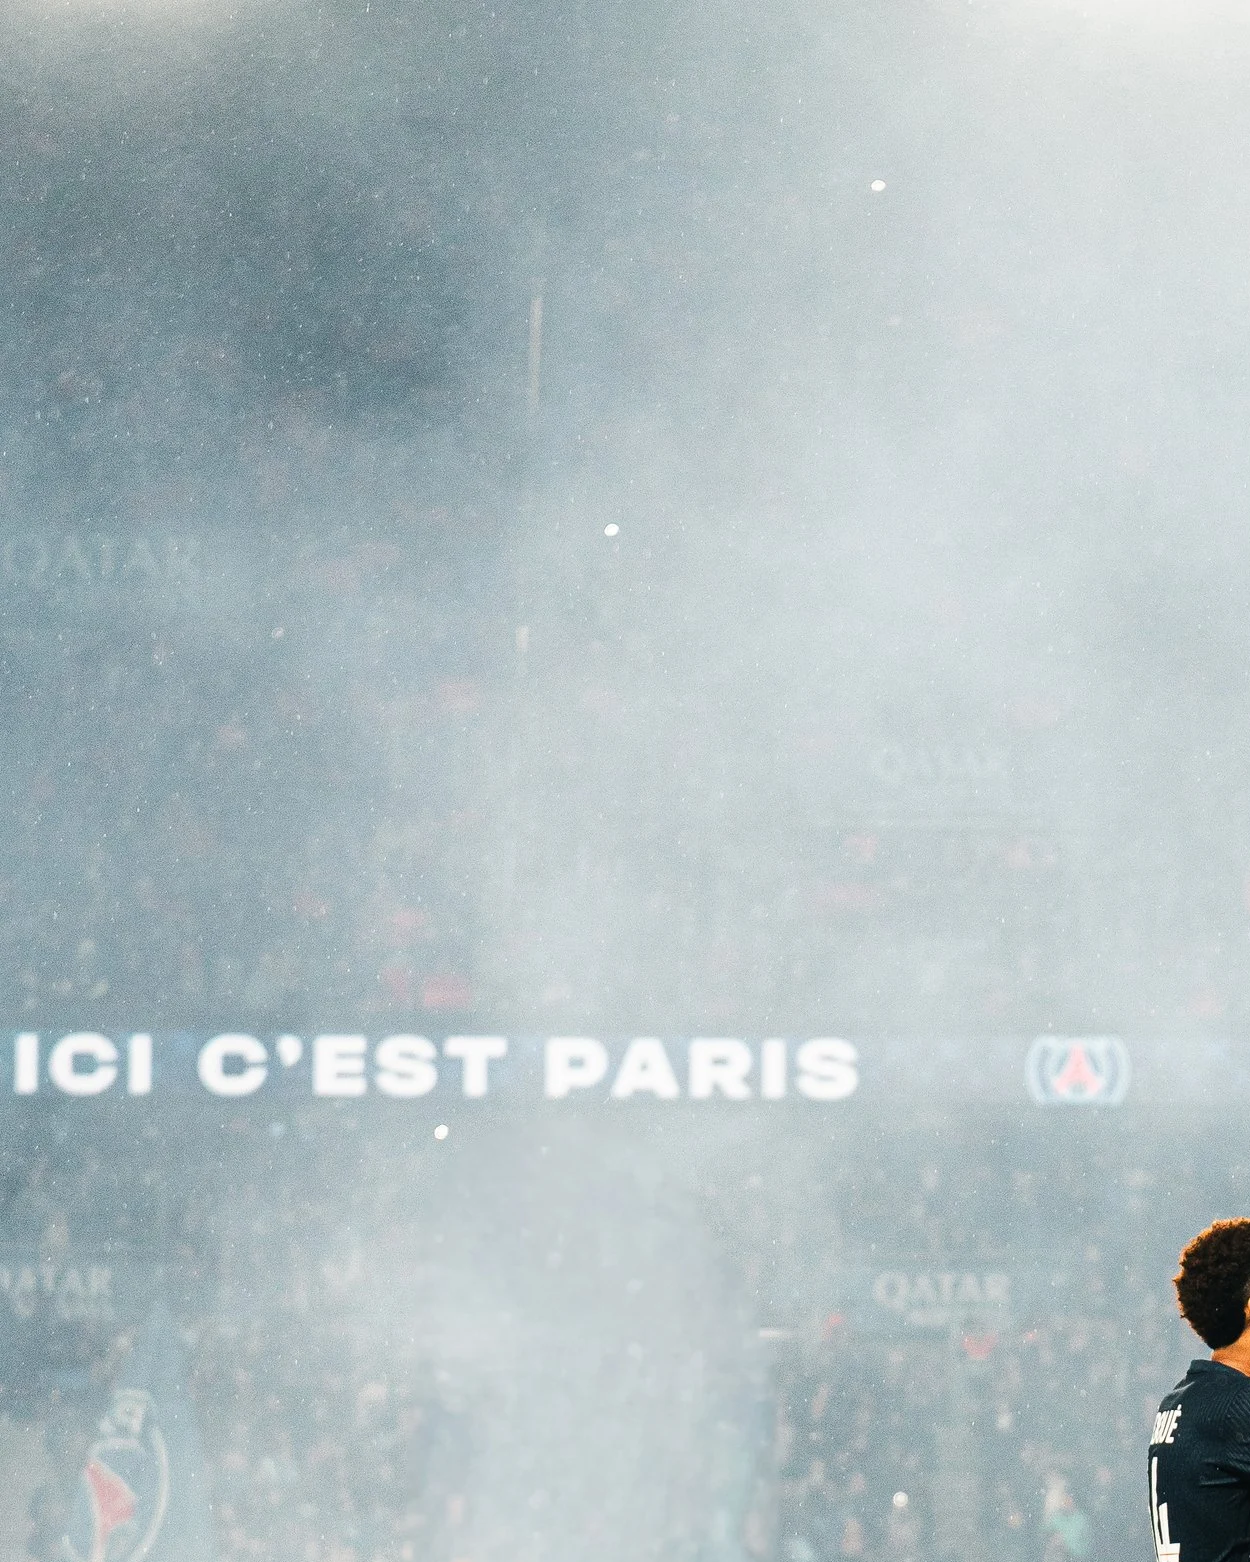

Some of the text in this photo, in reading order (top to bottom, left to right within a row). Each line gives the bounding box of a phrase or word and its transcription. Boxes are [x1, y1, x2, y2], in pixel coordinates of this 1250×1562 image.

[14, 1032, 860, 1102] ICI C'EST PARIS
